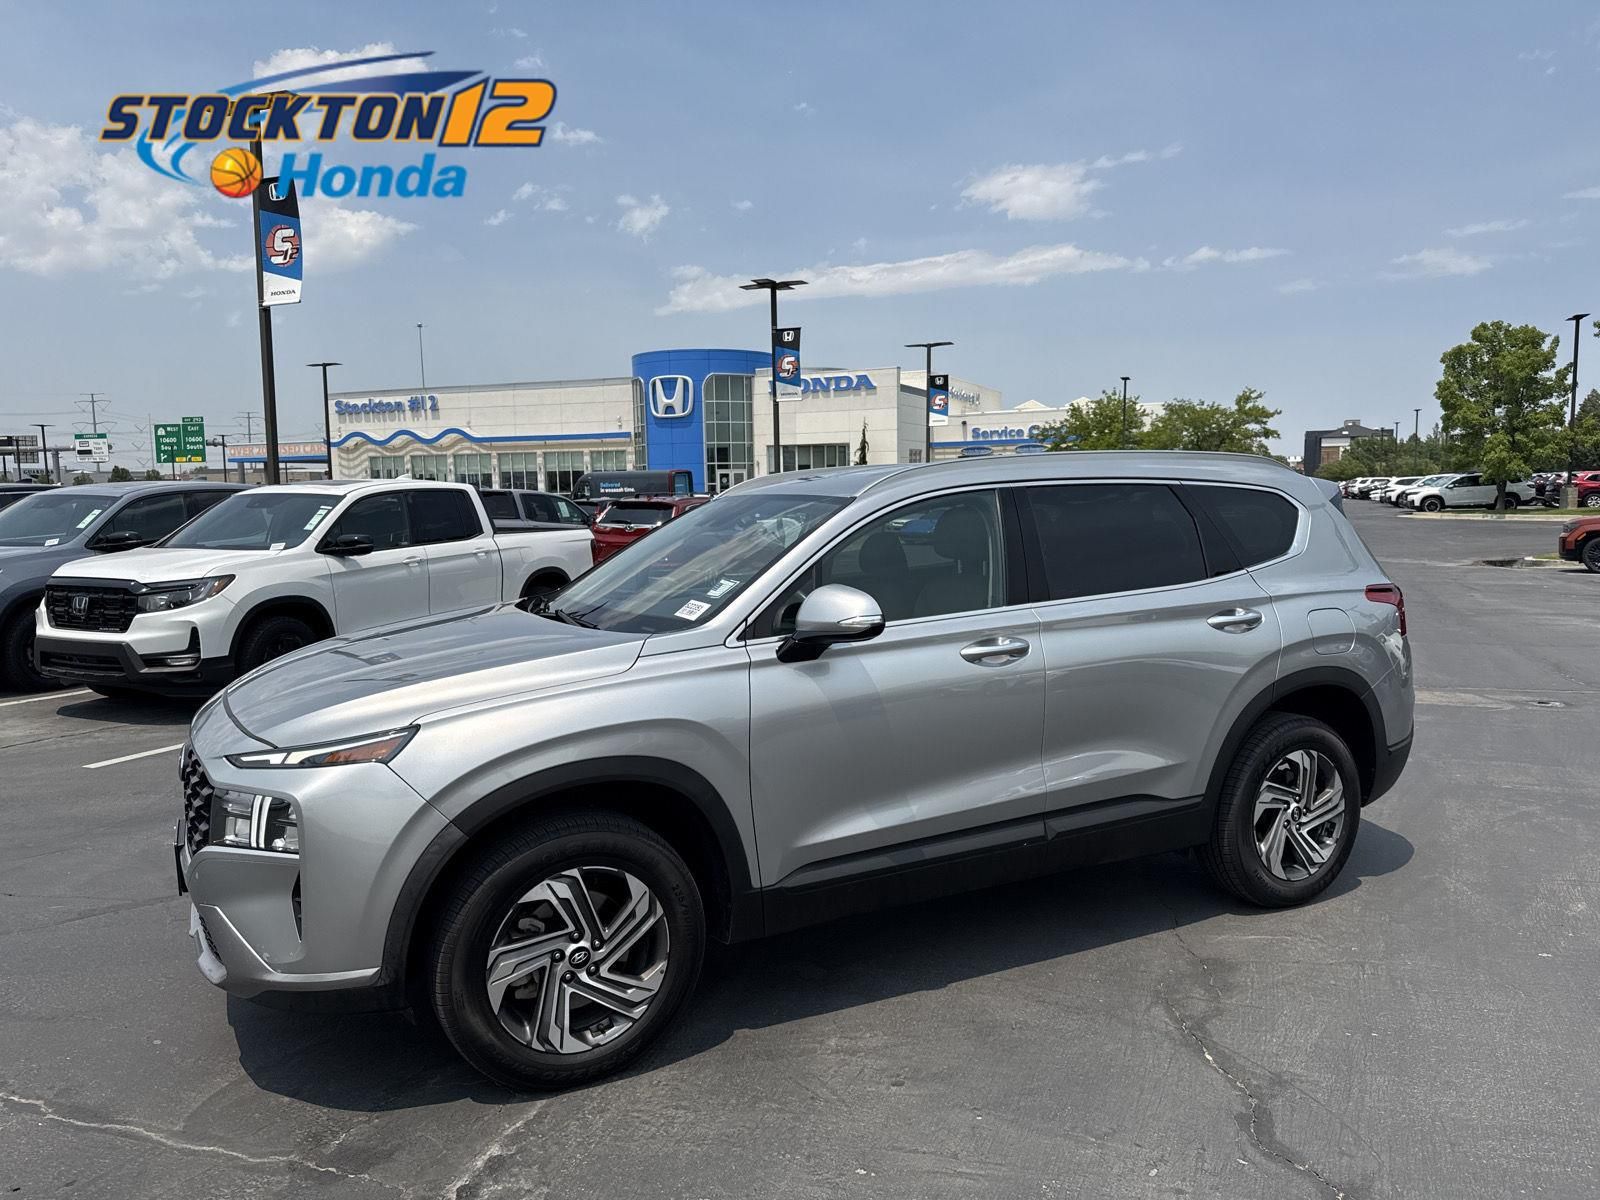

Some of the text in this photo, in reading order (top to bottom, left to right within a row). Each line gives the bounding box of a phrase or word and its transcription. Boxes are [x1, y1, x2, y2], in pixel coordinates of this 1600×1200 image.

[768, 374, 877, 396] ONDA
[335, 395, 438, 415] Stockton #12
[971, 422, 1025, 440] Service
